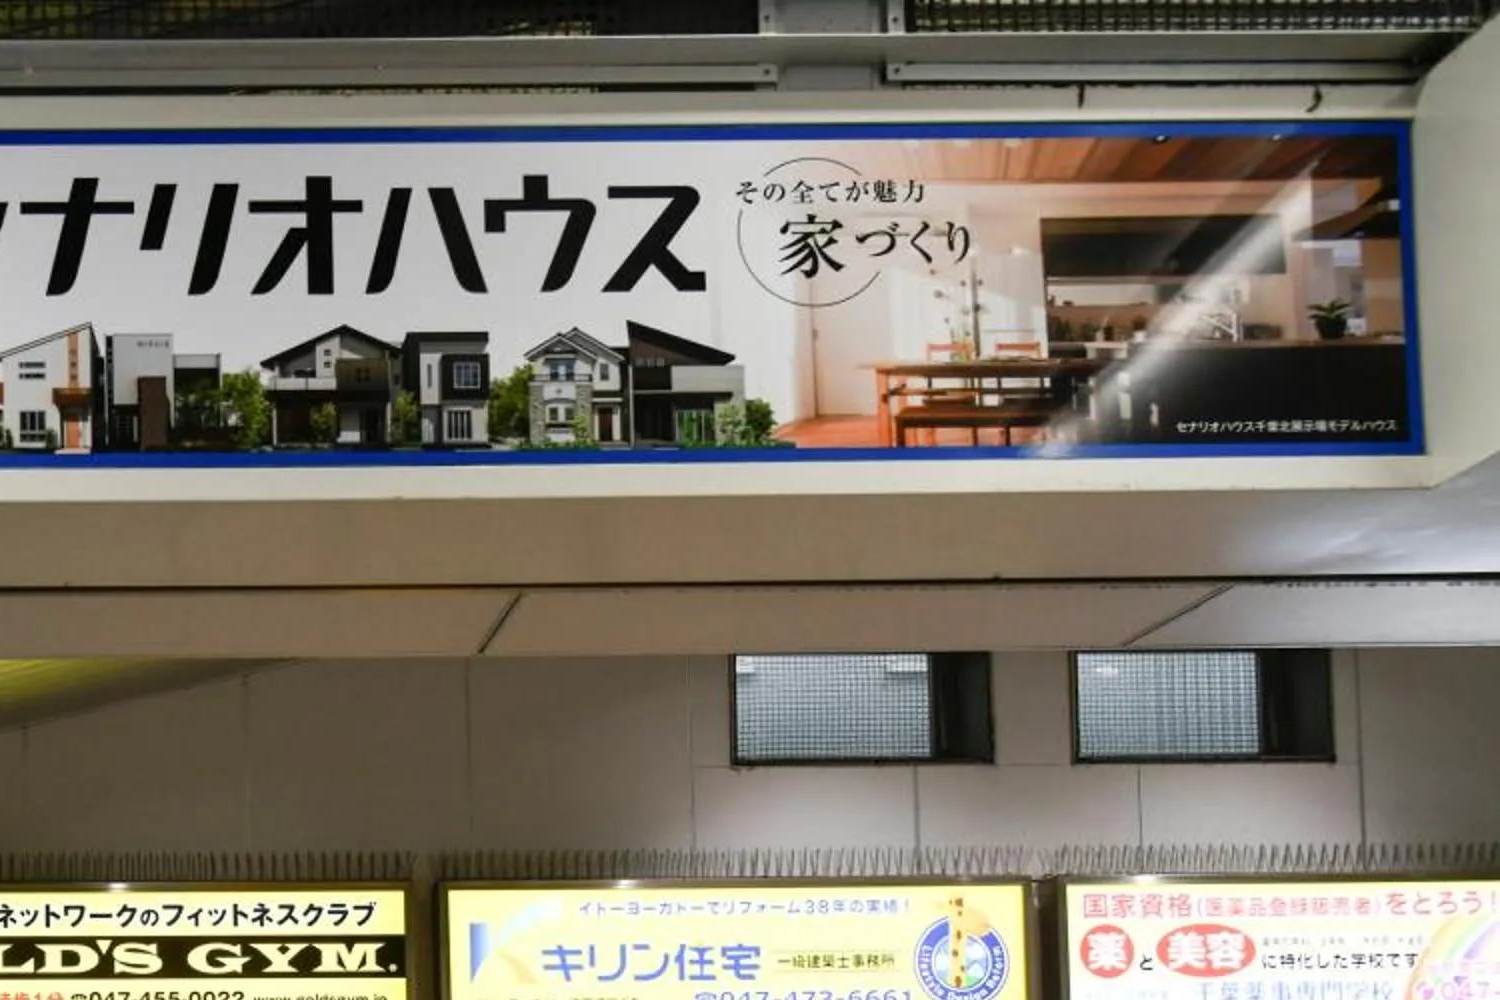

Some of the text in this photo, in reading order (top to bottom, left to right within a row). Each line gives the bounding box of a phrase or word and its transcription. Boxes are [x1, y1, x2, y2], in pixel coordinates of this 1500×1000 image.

[735, 179, 925, 204] その全てが魅力
[779, 214, 971, 280] 家づくり
[541, 943, 762, 982] キリン住宅
[1167, 931, 1248, 970] 美容
